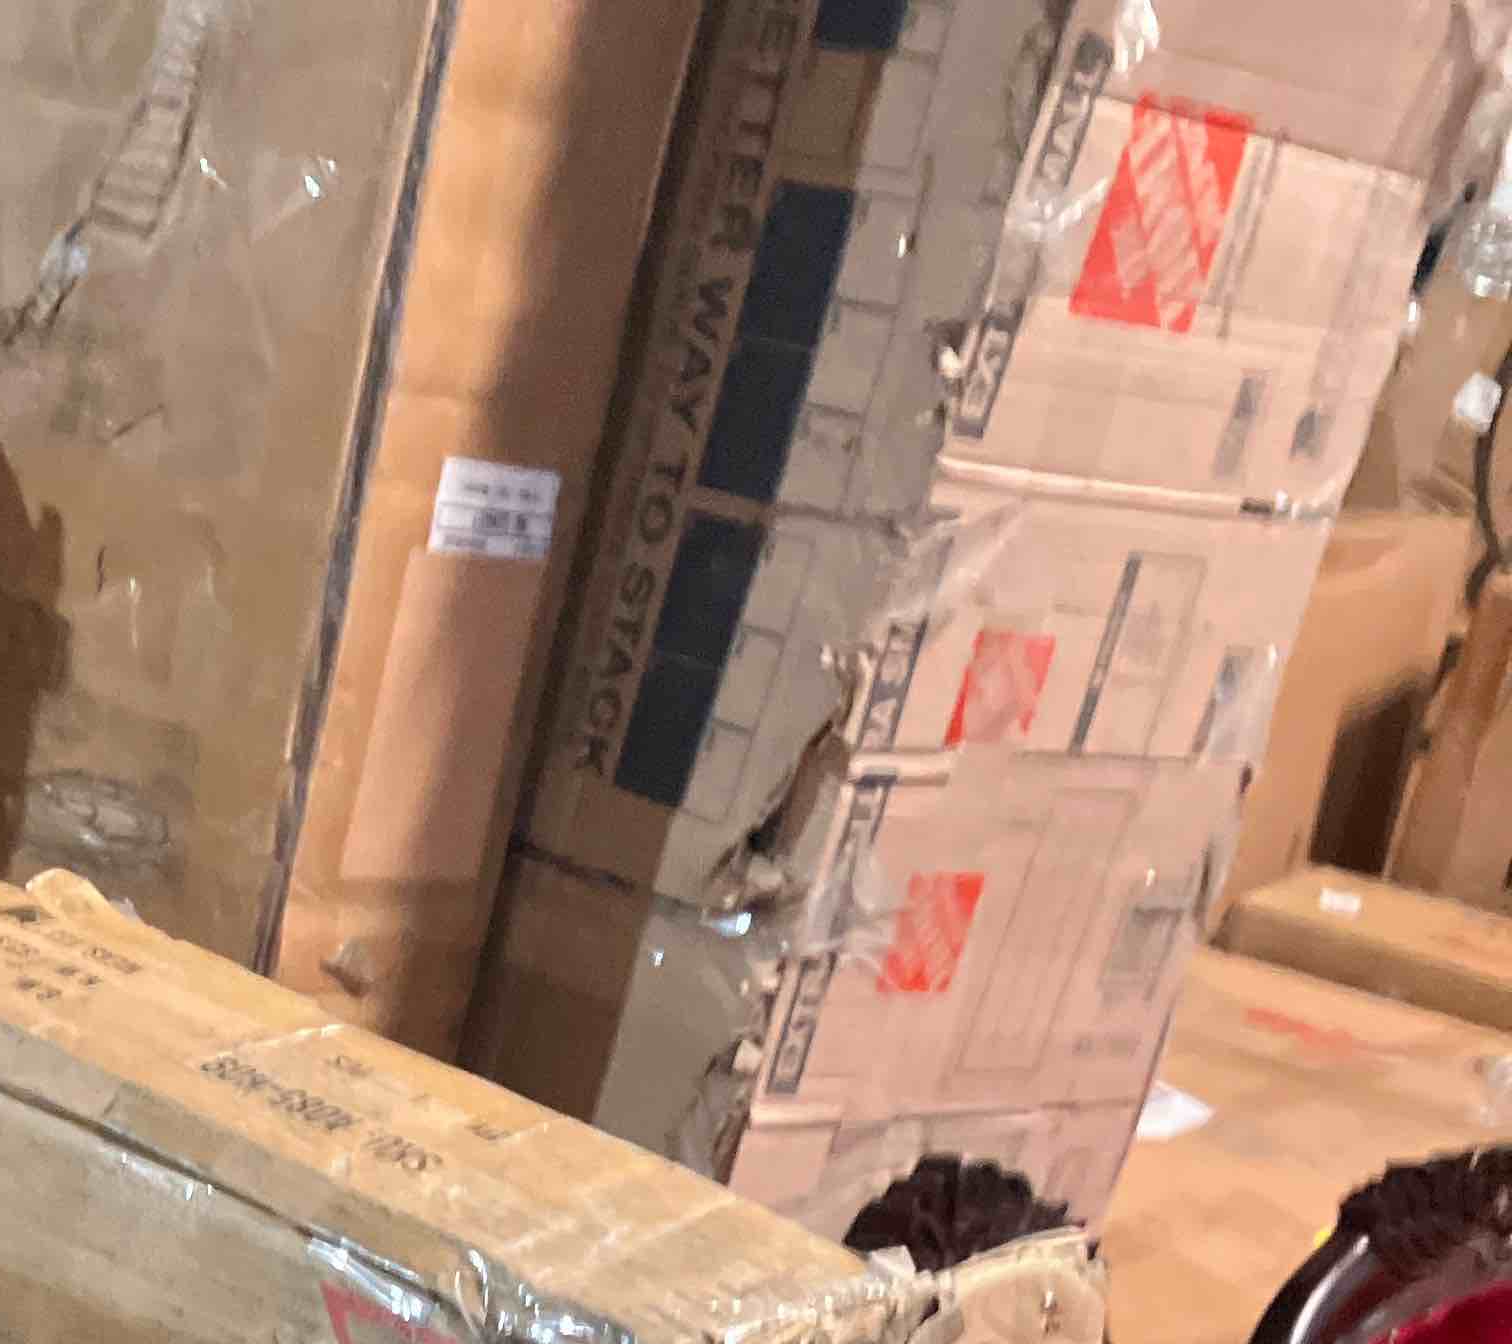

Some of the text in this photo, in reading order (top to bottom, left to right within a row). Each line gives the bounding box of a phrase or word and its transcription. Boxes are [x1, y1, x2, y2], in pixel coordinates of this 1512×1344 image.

[671, 275, 733, 434] WAY
[638, 461, 687, 545] TO
[575, 560, 656, 778] STACK
